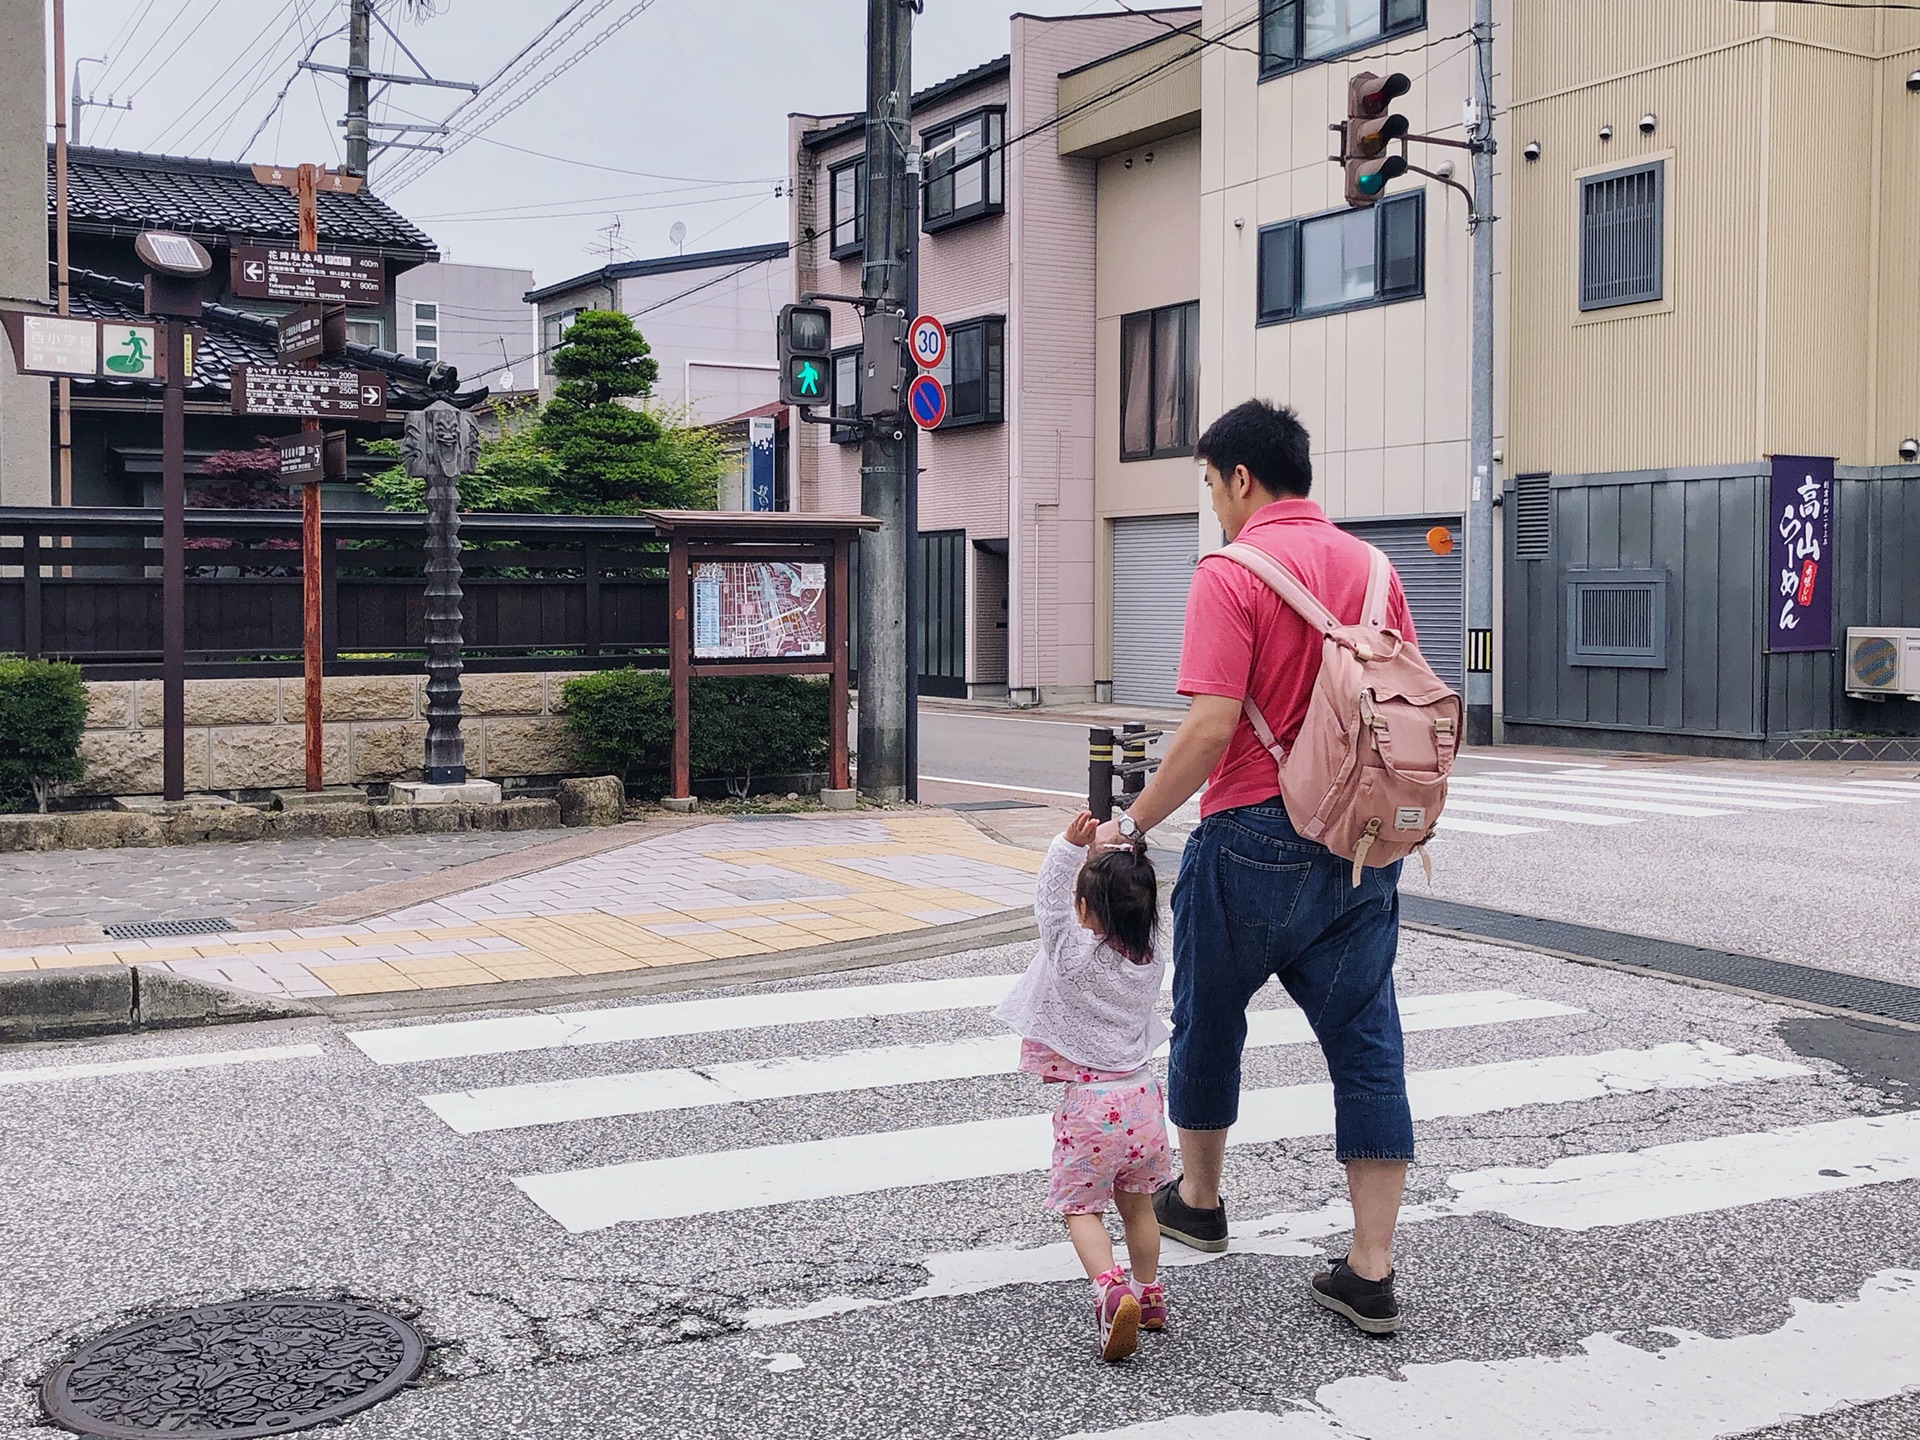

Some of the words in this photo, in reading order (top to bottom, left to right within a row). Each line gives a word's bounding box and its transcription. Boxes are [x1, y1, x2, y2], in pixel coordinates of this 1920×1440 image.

[268, 250, 323, 265] 花岡駐車場
[359, 260, 379, 268] 400m
[268, 259, 291, 267] Hanaoka
[268, 273, 351, 289] 高山駅
[359, 283, 379, 291] 900m
[268, 282, 295, 290] Takayama
[31, 331, 92, 348] 西小学校
[918, 330, 939, 354] 30
[339, 371, 358, 379] 200m
[339, 387, 358, 395] 250m
[339, 402, 358, 410] 250m
[1796, 474, 1821, 561] 高山
[1779, 504, 1801, 630] らーめん
